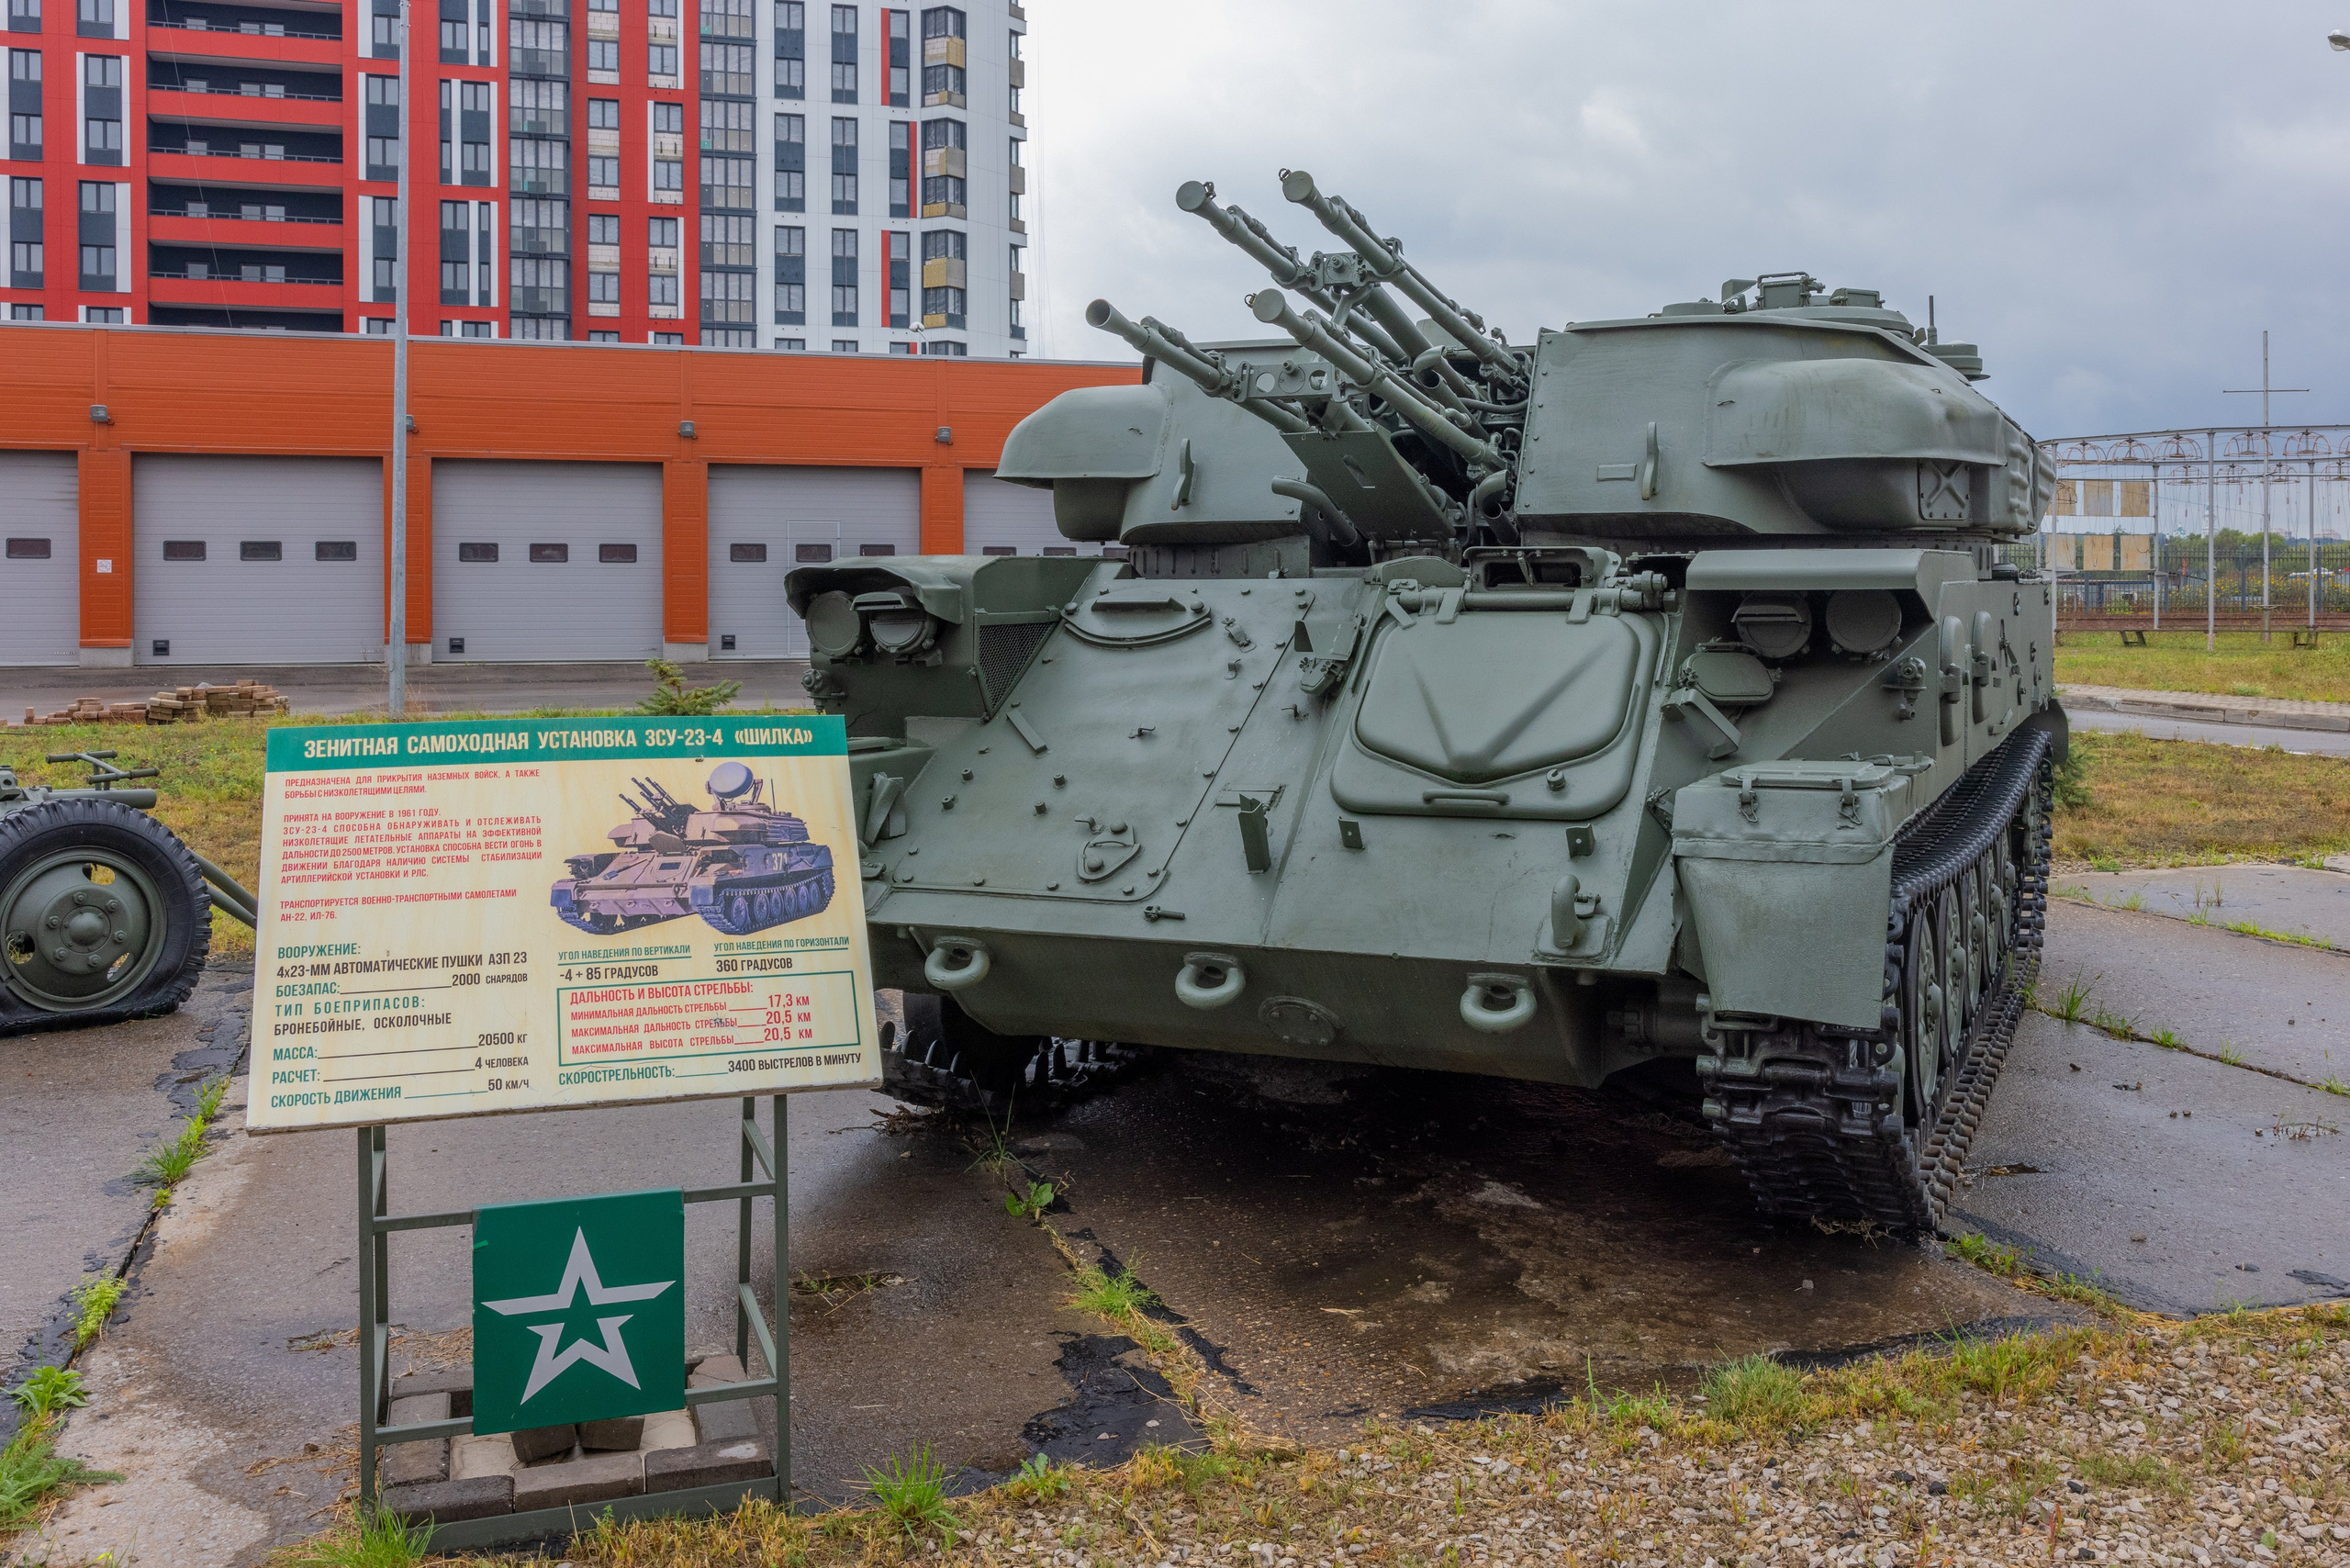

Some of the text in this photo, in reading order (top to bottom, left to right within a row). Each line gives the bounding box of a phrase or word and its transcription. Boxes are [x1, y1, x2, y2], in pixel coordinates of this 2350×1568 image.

[305, 728, 812, 757] ЗЕНИТНАЯ САМОХОДНАЯ УСТАНОВКА ЗСУ-23-4 «ШИЛКА»
[285, 777, 350, 787] ПРЕДНАЗНАЧЕНА
[356, 776, 372, 784] ДЛЯ
[377, 774, 422, 782] ПРИКРЫТИЯ
[428, 772, 469, 780] НАЗЕМНЫХ
[285, 790, 317, 799] БОРЬБЫ
[324, 787, 393, 797] НИЗКОЛЕТЯЩИМИ
[394, 786, 427, 794] ЦЕЛЯМИ.
[284, 813, 319, 823] ПРИНЯТА
[335, 811, 386, 820] ВООРУЖЕНИЕ
[284, 825, 327, 834] ЗСУ-23-4
[334, 823, 380, 832] СПОСОБНА
[387, 820, 459, 830] ОБНАРУЖИВАТЬ
[477, 816, 541, 825] ОТСЛЕЖИВАТЬ
[283, 836, 348, 846] НИЗКОЛЕТЯЩИЕ
[354, 834, 412, 843] ЛЕТАТЕЛЬНЫЕ
[419, 831, 460, 840] АППАРАТЫ
[483, 826, 541, 837] ЭФФЕКТИВНОЙ
[282, 850, 329, 860] ДАЛЬНОСТИ
[330, 849, 341, 857] ДО
[342, 847, 363, 856] 2500
[363, 846, 396, 855] МЕТРОВ.
[397, 845, 440, 853] УСТАНОВКА
[443, 843, 481, 851] СПОСОБНА
[485, 841, 508, 849] ВЕСТИ
[511, 840, 533, 848] ОГОНЬ
[282, 852, 542, 872] ДВИЖЕНИИ БЛАГОДАРЯ НАЛИЧИЮ СИСТЕМЫ СТАБИЛИЗАЦИИ
[281, 872, 352, 883] АРТИЛЛЕРИЙСКОЙ
[356, 870, 400, 879] УСТАНОВКИ
[280, 890, 516, 909] ТРАНСПОРТИРУЕТСЯ ВОЕННО-ТРАНСПОРТНЫМИ САМОЛЕТАМИ
[310, 911, 337, 920] ИЛ-76.
[278, 943, 361, 958] ВООРУЖЕНИЕ:
[558, 945, 690, 960] УГОЛ НАВЕДЕНИЯ ПО ВЕРТИКАЛИ
[714, 936, 849, 953] УГОЛ НАВЕДЕНИЯ ПО ГОРИЗОНТАЛИ
[334, 957, 438, 974] АВТОМАТИЧЕСКИЕ
[442, 955, 482, 968] ПУШКИ
[488, 953, 509, 965] АЗП
[514, 952, 527, 963] 23
[716, 958, 792, 972] 360 ГРАДУСОВ
[560, 969, 572, 981] -4
[587, 968, 600, 980] 85
[605, 966, 658, 979] ГРАДУСОВ
[276, 973, 527, 997] БОЕЗАПАС: 2000 СНАРЯДОВ
[570, 982, 753, 1005] ДАЛЬНОСТЬ И ВЫСОТА СТРЕЛЬБЫ:
[275, 996, 426, 1016] ТИП БОЕПРИПАСОВ:
[571, 993, 809, 1020] МИНИМАЛЬНАЯ ДАЛЬНОСТЬ СТРЕЛЬБЫ 17,3 КМ
[274, 1013, 451, 1036] БРОНЕБОЙНЫЕ, ОСКОЛОЧНЫЕ
[572, 1025, 639, 1037] МАКСИМАЛЬНАЯ
[643, 1022, 690, 1033] ДАЛЬНОСТЬ
[767, 1010, 791, 1025] 20,5
[798, 1013, 811, 1022] КМ
[274, 1032, 527, 1060] МАССА: 20500 КГ
[572, 1027, 812, 1054] МАКСИМАЛЬНАЯ ВЫСОТА СТРЕЛЬБЫ 20,5 КМ
[273, 1057, 528, 1084] РАСЧЕТ: 4 ЧЕЛОВЕКА
[559, 1053, 860, 1085] СКОРОСТРЕЛЬНОСТЬ: 3400 ВЫСТРЕЛОВ В МИНУТУ
[272, 1079, 529, 1107] СКОРОСТЬ ДВИЖЕНИЯ 50 КМ/Ч
